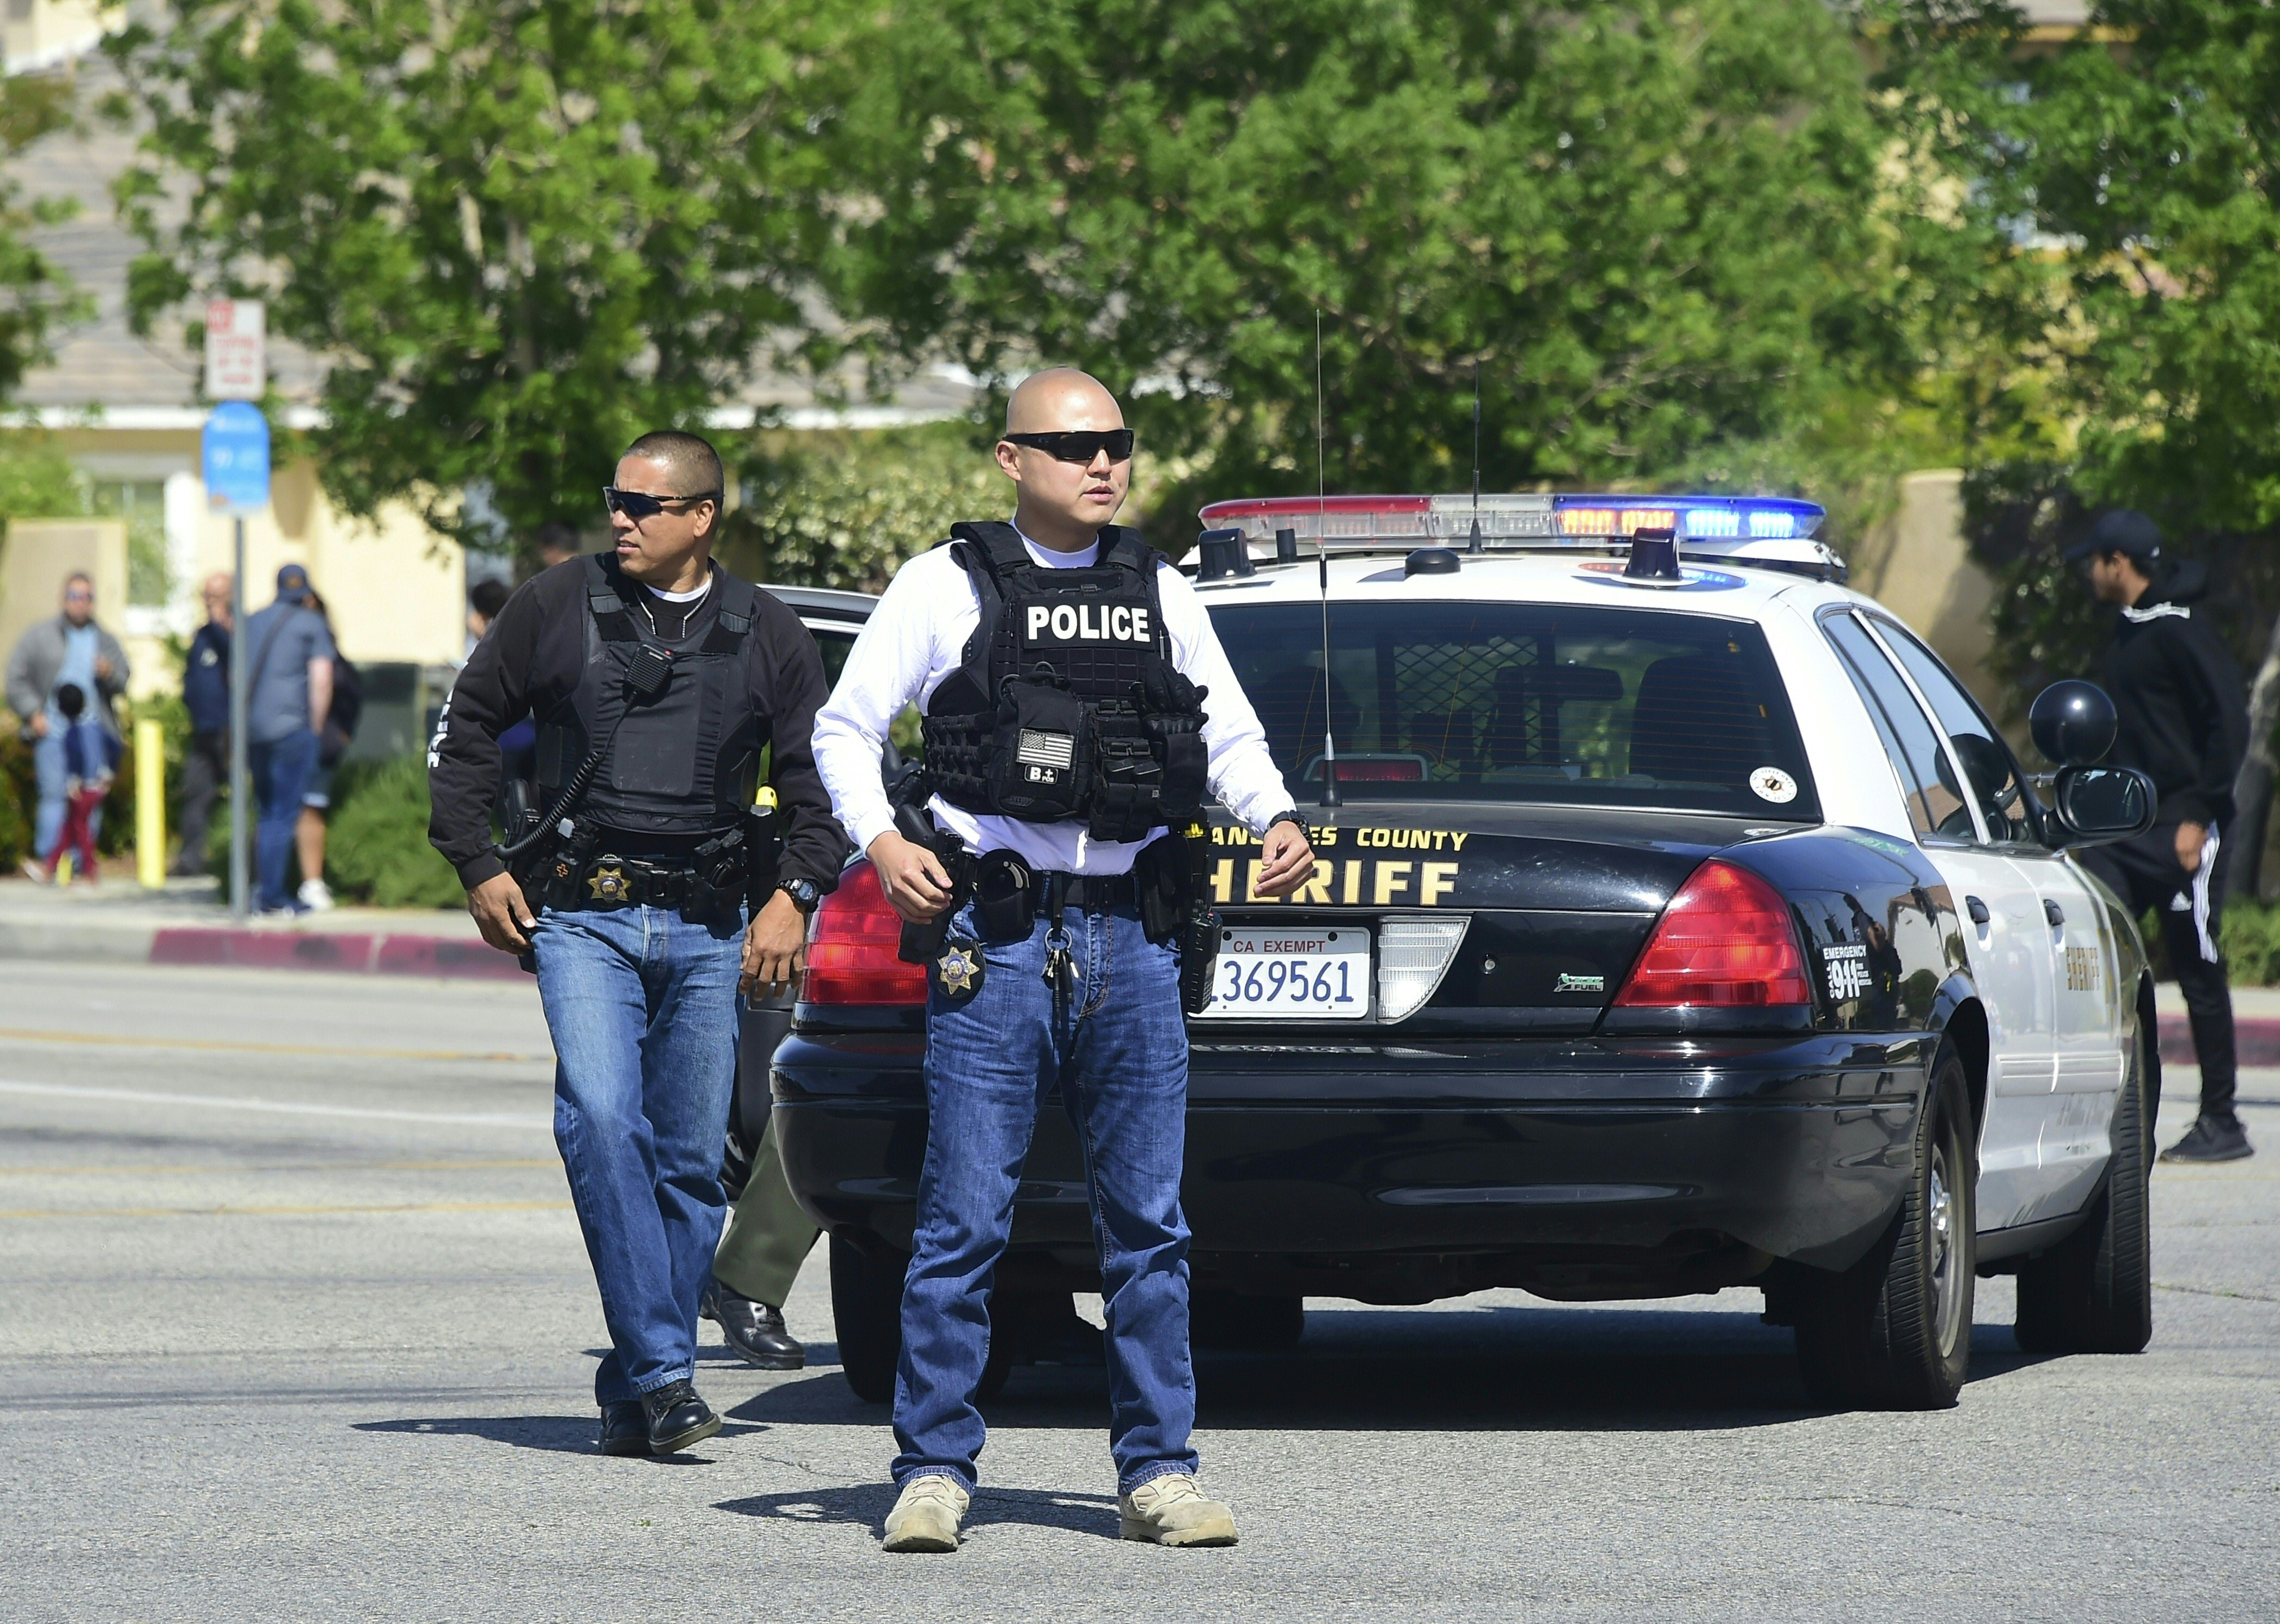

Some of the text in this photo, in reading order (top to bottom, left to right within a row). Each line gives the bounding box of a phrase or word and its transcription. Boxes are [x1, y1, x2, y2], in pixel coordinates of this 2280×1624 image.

[1027, 604, 1151, 642] POLICE
[1212, 827, 1468, 851] ANES COUNTY
[1211, 859, 1459, 906] HERIFF
[1233, 941, 1326, 953] CA EXEMPT
[1823, 944, 1866, 960] EMERGENCY
[1212, 960, 1354, 1003] 369561
[1826, 962, 1835, 999] CALL
